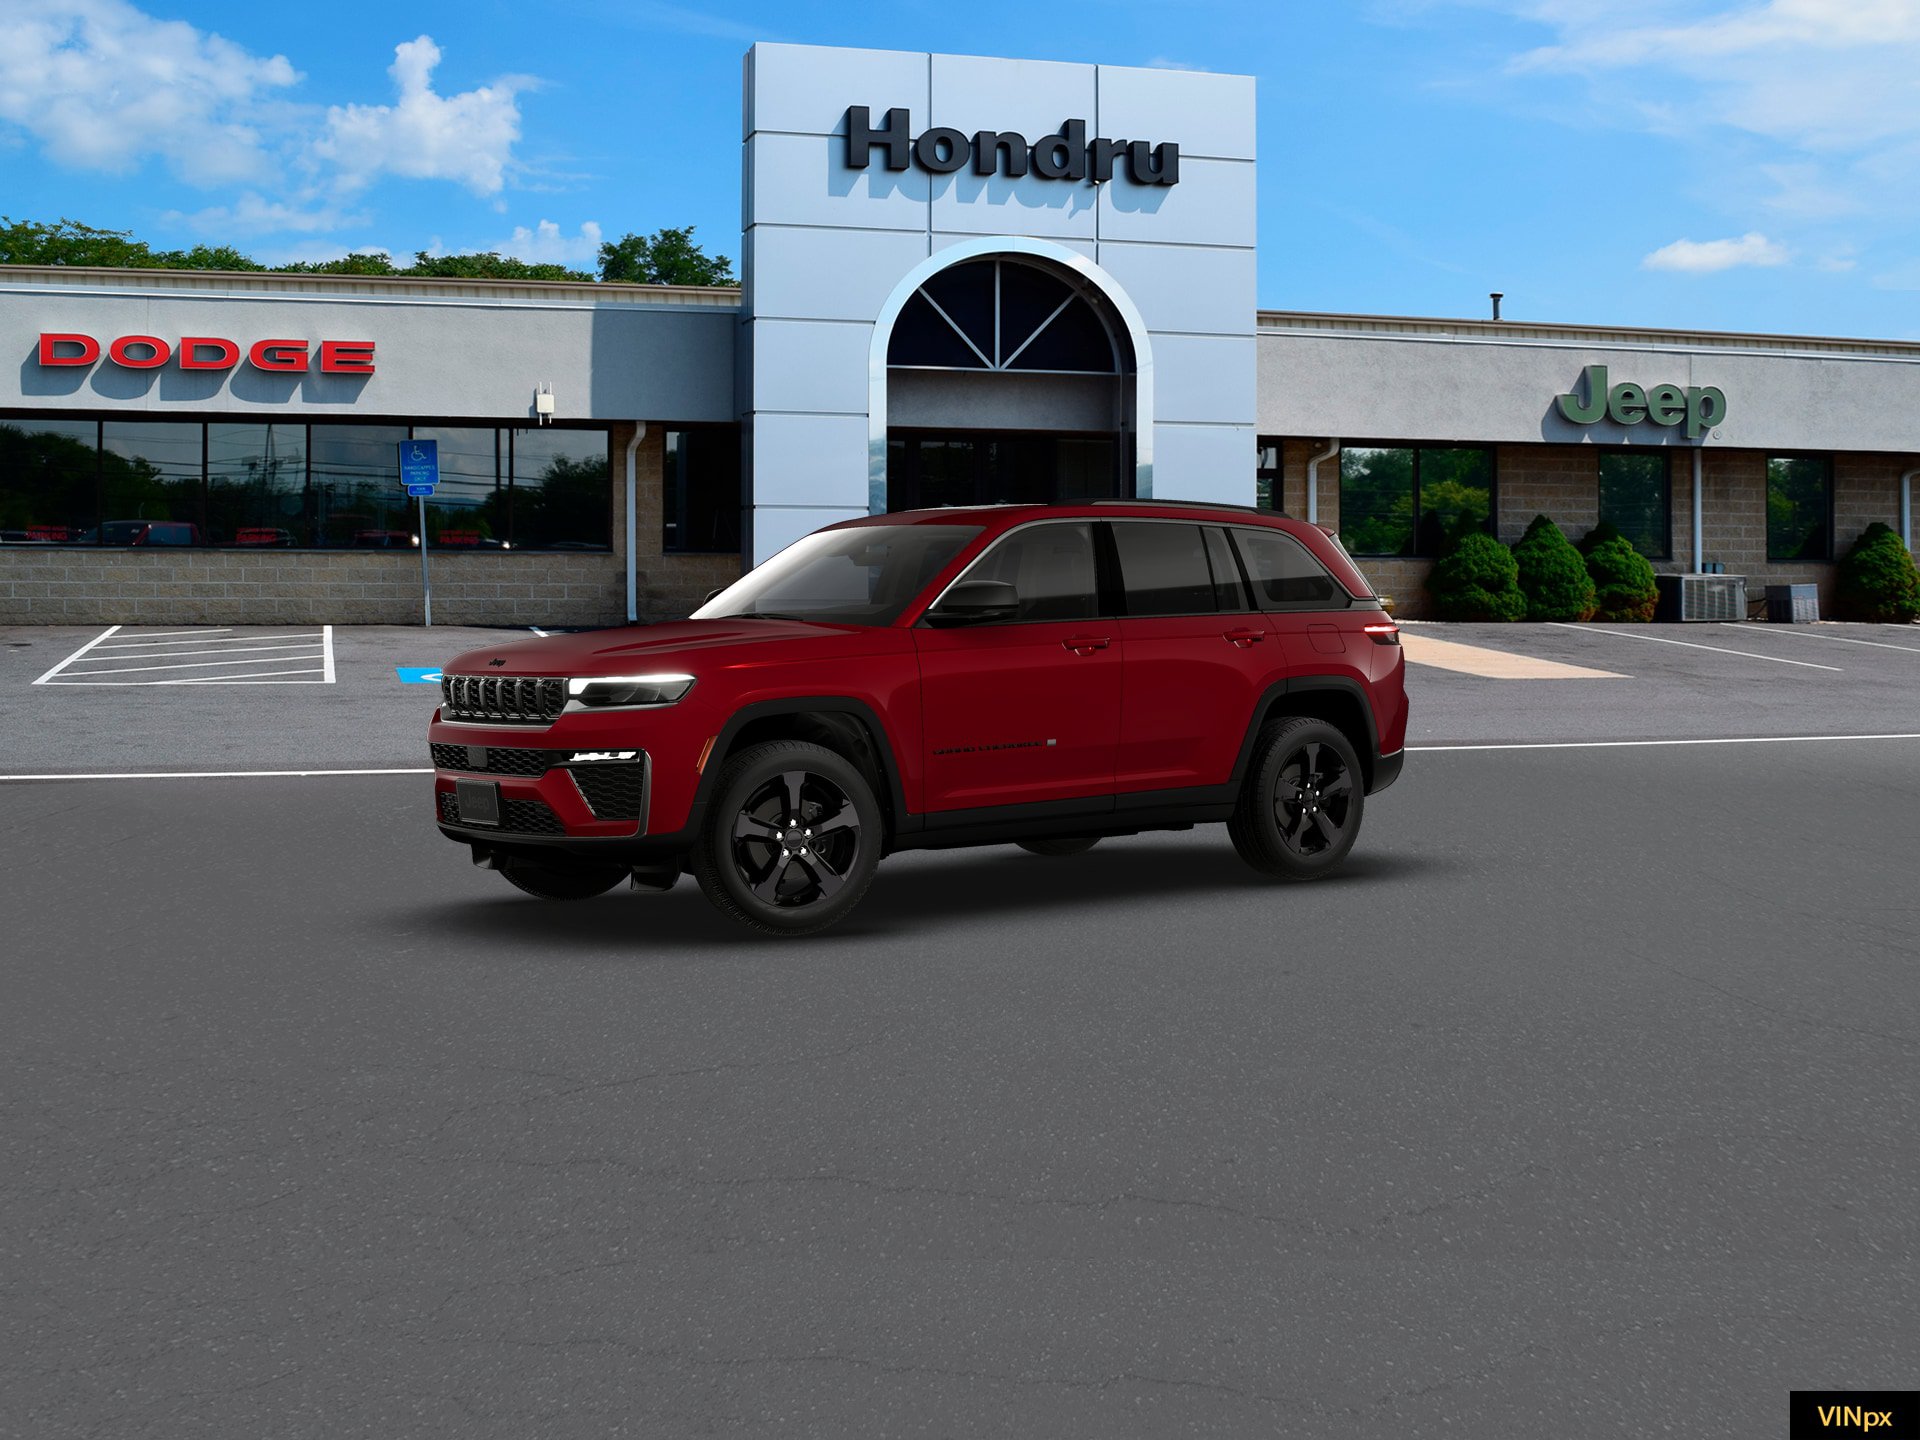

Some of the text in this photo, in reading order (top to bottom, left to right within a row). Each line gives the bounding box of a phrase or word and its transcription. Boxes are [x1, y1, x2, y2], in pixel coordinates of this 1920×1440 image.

[847, 105, 1179, 186] Hondru
[39, 333, 375, 374] DODGE
[1556, 365, 1727, 439] Jeep
[464, 790, 490, 813] Jeep
